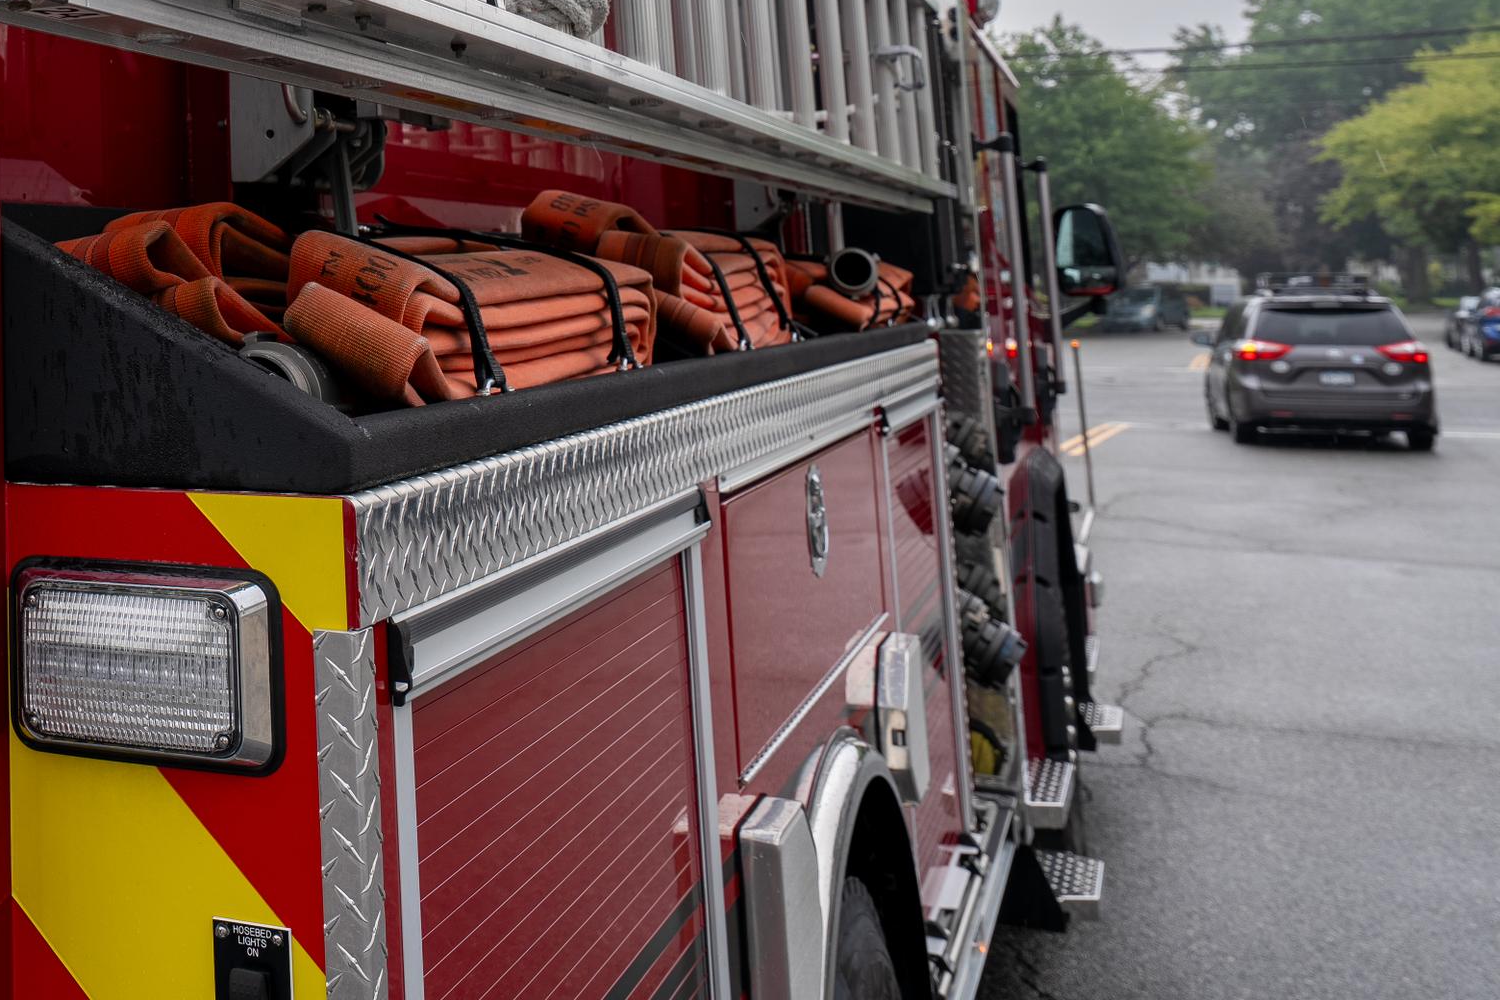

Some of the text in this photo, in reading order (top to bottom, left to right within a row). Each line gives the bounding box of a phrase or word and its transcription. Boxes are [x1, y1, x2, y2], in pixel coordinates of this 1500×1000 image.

[232, 925, 272, 939] HOSEBED
[237, 935, 267, 949] LIGHTS
[247, 947, 259, 958] ON
